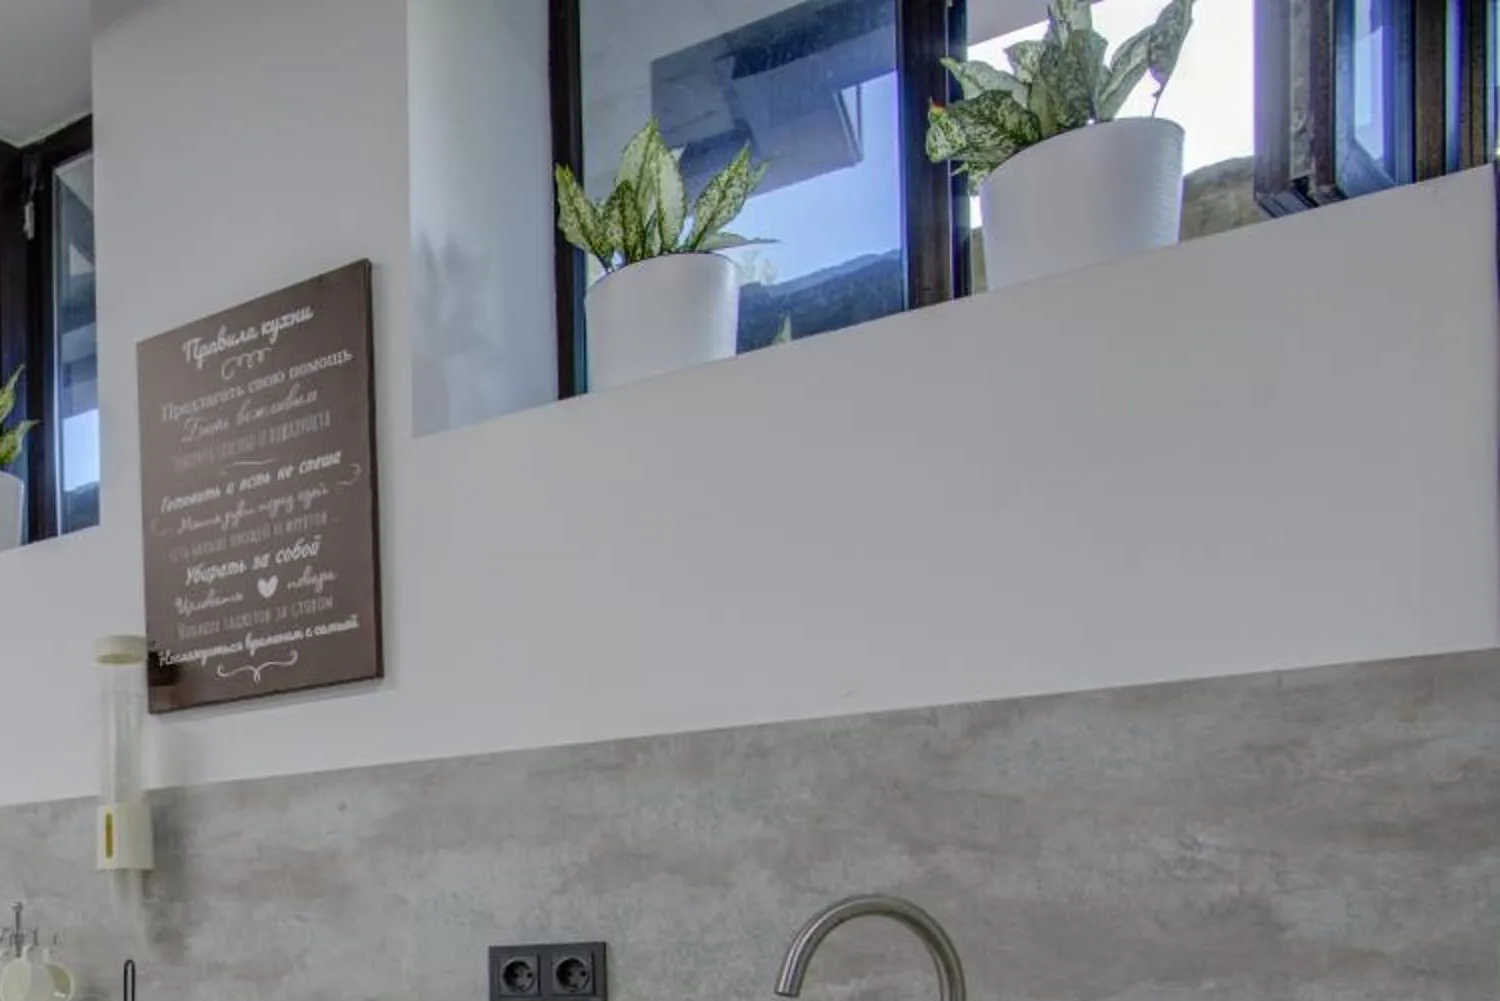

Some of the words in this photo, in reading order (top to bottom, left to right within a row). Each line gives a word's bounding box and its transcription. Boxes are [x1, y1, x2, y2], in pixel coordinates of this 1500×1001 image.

[182, 324, 258, 370] Правила
[261, 306, 314, 345] кухни
[275, 534, 323, 564] собой
